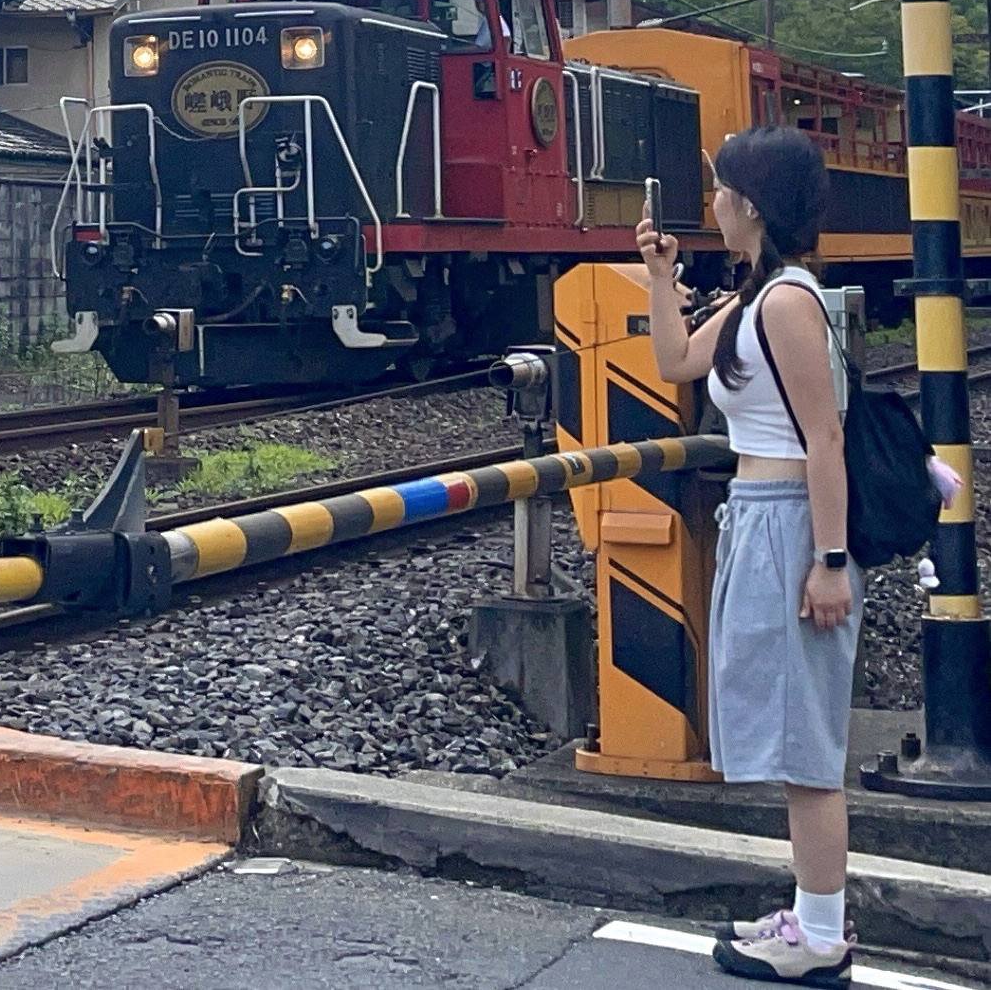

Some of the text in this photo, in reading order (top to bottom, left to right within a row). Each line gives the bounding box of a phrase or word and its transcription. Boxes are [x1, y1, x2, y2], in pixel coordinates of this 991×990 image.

[225, 26, 267, 47] 1104
[182, 69, 257, 91] ROMANTIC TRAIN
